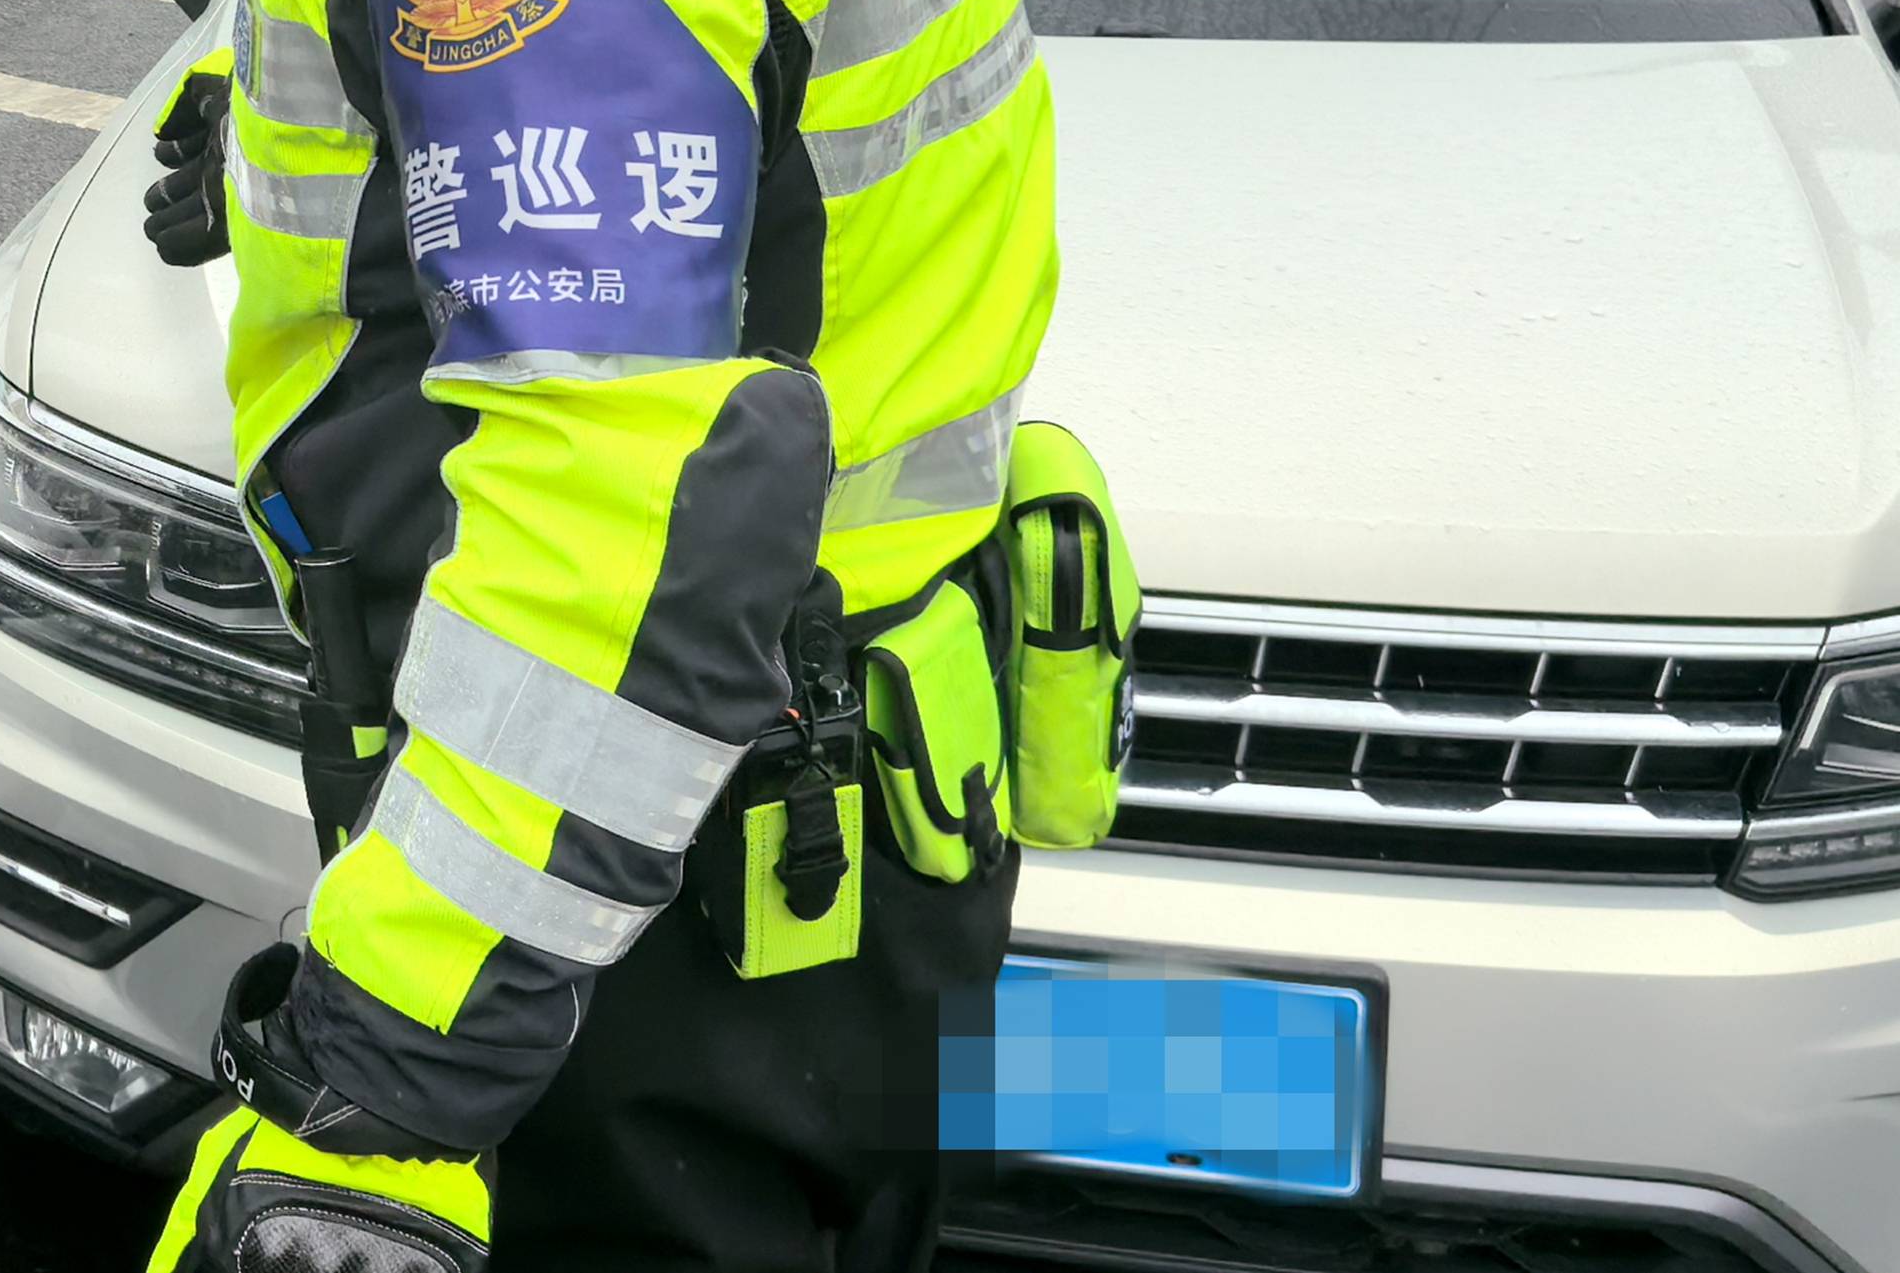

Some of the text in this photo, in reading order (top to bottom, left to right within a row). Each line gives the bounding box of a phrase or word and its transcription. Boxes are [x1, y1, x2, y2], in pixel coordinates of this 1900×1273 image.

[431, 28, 509, 61] JINGCHA
[404, 125, 725, 261] 警巡逻
